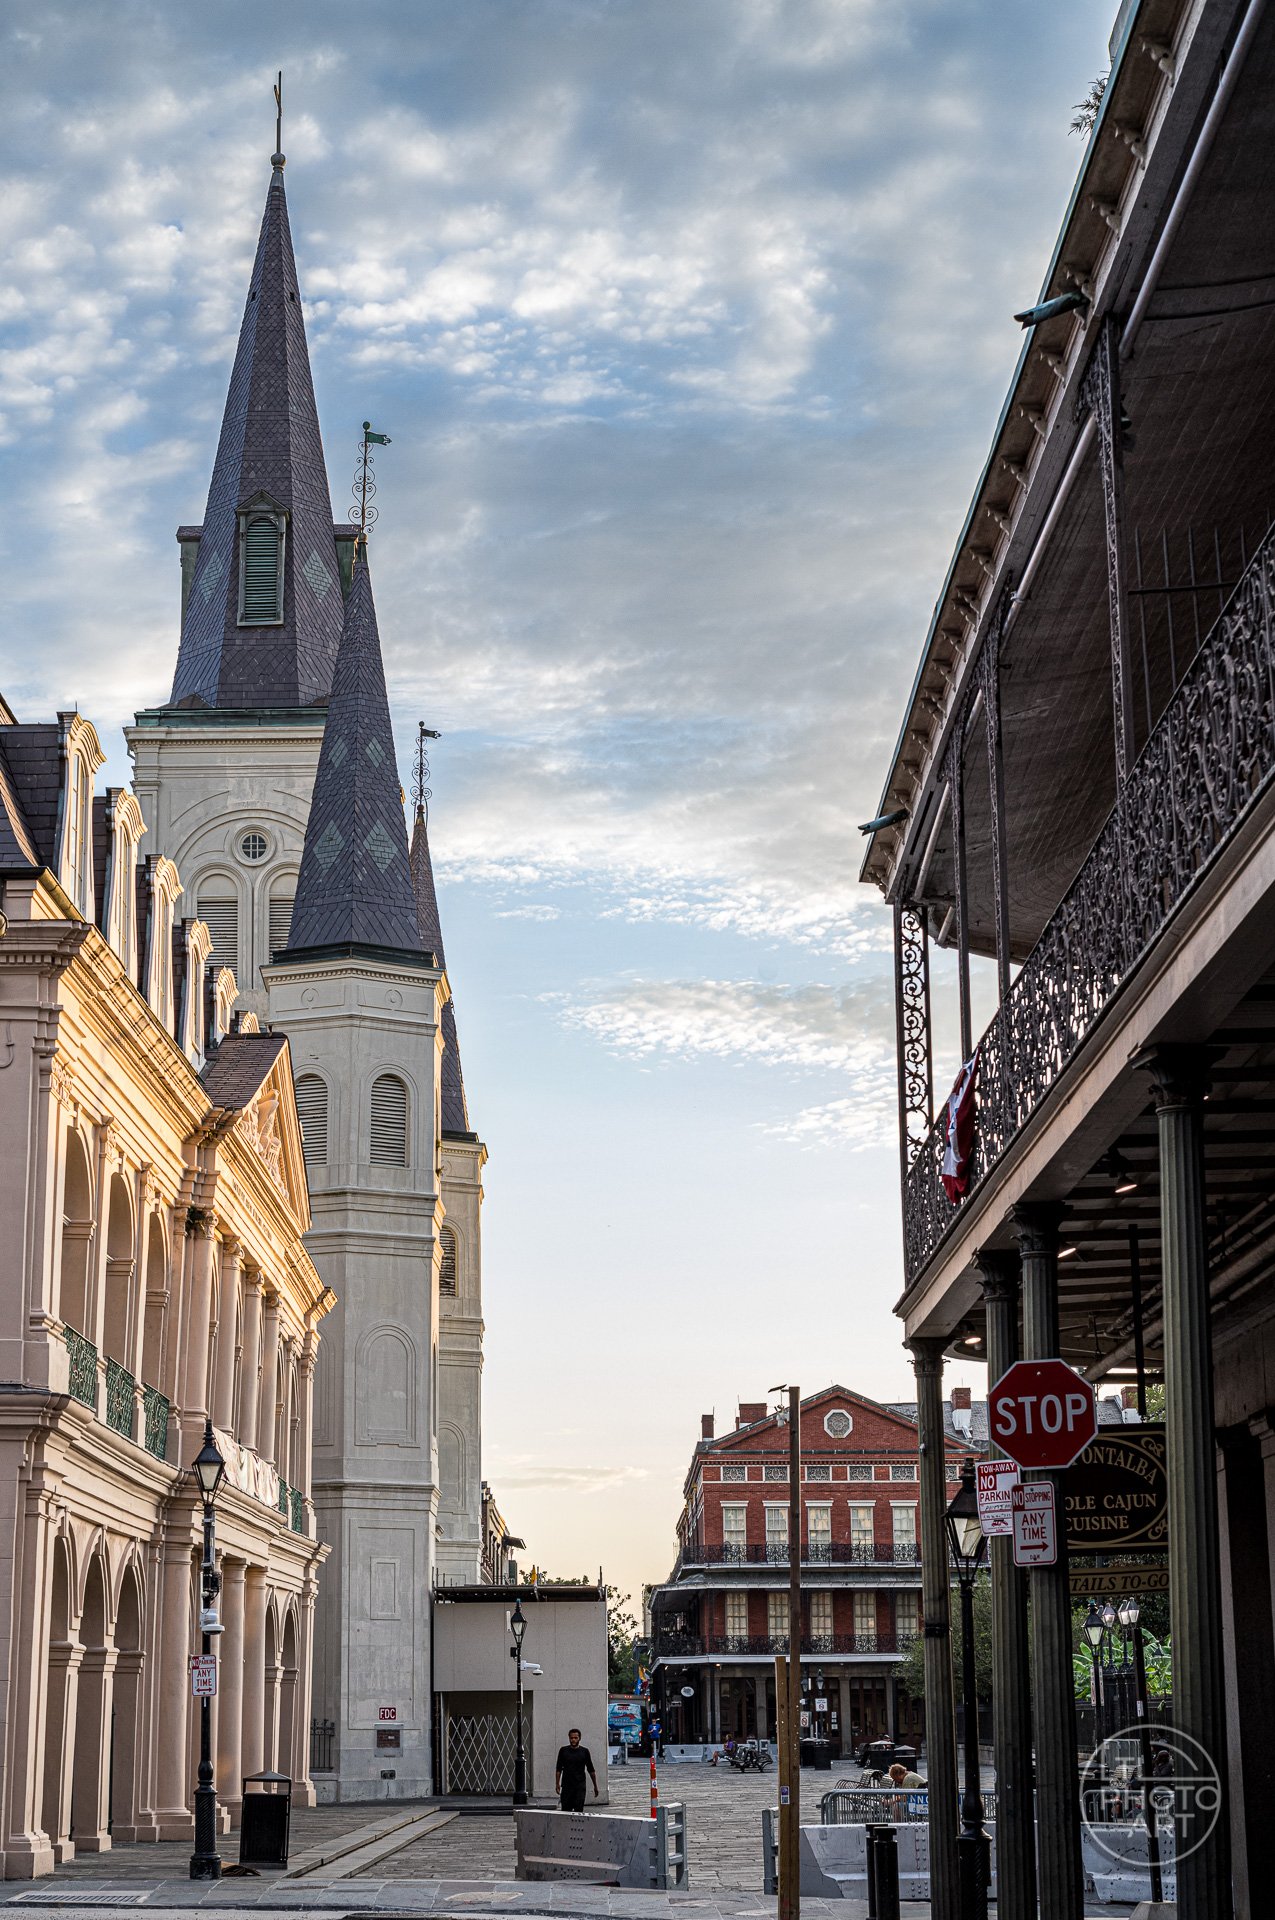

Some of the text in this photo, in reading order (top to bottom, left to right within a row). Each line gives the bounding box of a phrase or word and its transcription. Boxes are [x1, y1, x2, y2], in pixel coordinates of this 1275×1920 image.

[996, 1393, 1088, 1436] STOP
[980, 1463, 1015, 1474] TOW-AWAY
[1073, 1446, 1158, 1486] ONTALBA
[980, 1475, 995, 1490] NO
[979, 1490, 1011, 1503] PARKIN
[1012, 1491, 1051, 1506] NO STOPPING
[1103, 1493, 1157, 1511] CAJUN
[1022, 1512, 1046, 1526] ANY
[1065, 1515, 1130, 1532] CUISINE
[1022, 1527, 1047, 1540] TIME
[1121, 1573, 1169, 1589] TO-GO
[197, 1669, 211, 1678] ANY
[196, 1679, 212, 1687] TIME
[380, 1709, 395, 1719] FDC
